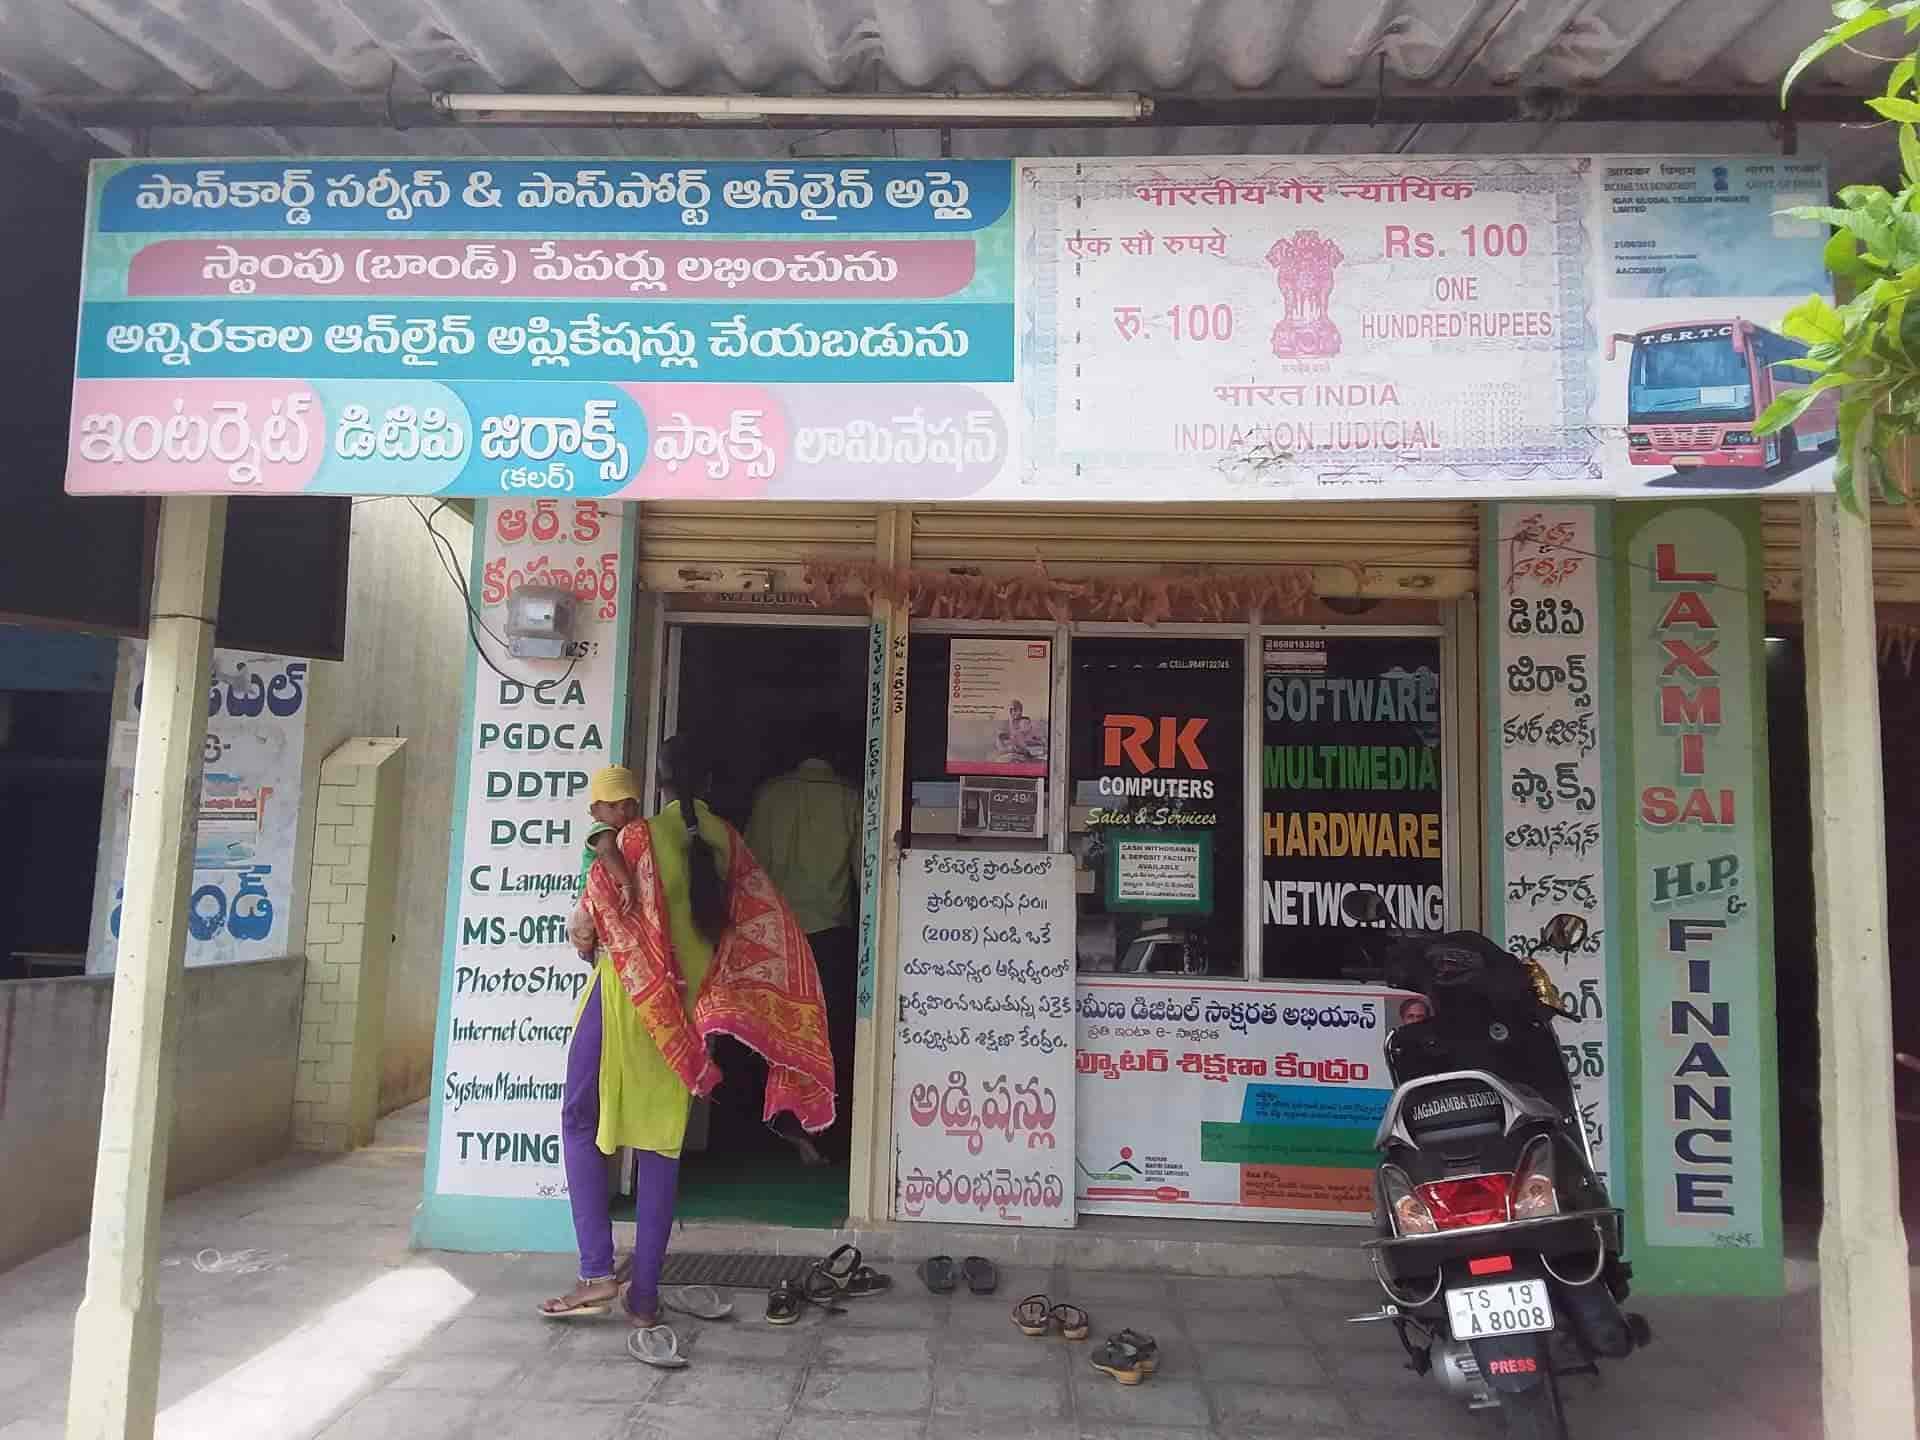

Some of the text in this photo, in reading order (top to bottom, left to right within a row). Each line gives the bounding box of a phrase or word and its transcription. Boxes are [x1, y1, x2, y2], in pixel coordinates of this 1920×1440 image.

[327, 169, 450, 221] సర్వీస్
[462, 170, 501, 209] &
[886, 171, 972, 220] అప్లై
[1136, 176, 1473, 206] भारतीय गैर न्यायिक
[1065, 228, 1227, 258] एक सौ रुपये
[1385, 223, 1528, 258] Rs. 100
[202, 241, 898, 294] స్టాంపు (బాండ్) పేపర్లు లభించును
[1435, 276, 1478, 302] ONE
[1168, 304, 1232, 341] 100
[1362, 312, 1551, 339] HUNDRED RUPEES
[107, 319, 312, 366] అన్నిరకాల
[488, 314, 698, 368] అప్లికేషన్లు
[708, 315, 969, 359] చేయబడును
[1214, 384, 1400, 407] भारत INDIA
[79, 392, 312, 485] ఇంటర్నెట్
[335, 404, 464, 460] డిటిపి
[480, 400, 629, 481] జిరాక్స్
[794, 404, 998, 473] లామినేషన్
[1174, 423, 1243, 450] INDIA
[1327, 420, 1440, 450] JUDICIAL
[500, 464, 575, 491] (కలర్)
[1656, 543, 1721, 776] LAXMI
[1507, 654, 1592, 707] జిరాక్స్
[1266, 677, 1439, 722] SOFTWARE
[479, 723, 603, 750] PGDCA
[1104, 714, 1208, 775] RK
[1263, 745, 1439, 790] MULTIMEDIA
[487, 771, 588, 798] DDTP
[1100, 776, 1215, 799] COMPUTERS
[1085, 807, 1216, 825] Sales & Services
[1641, 786, 1736, 826] SAI
[491, 820, 570, 844] DCH
[1263, 812, 1441, 858] HARDWARE
[470, 865, 582, 900] C Languag
[983, 856, 1052, 881] ప్రాంతంలో
[922, 923, 1052, 948] (2008) నుండి ఒకే
[456, 966, 588, 999] PhotoShop
[453, 1017, 574, 1044] Internet Concep
[1131, 995, 1201, 1022] డిజిటల్
[1206, 1000, 1276, 1034] సాక్షరత
[1283, 1004, 1376, 1030] అభియాన్
[1275, 1051, 1369, 1083] కేంద్రం
[1669, 919, 1735, 1216] FINANCE
[446, 1072, 493, 1112] System
[1411, 1095, 1468, 1121] JAGADAMBA
[1469, 1091, 1503, 1109] HONDA
[457, 1131, 560, 1164] TYPING
[904, 1167, 1063, 1221] ప్రారంభమైనవి
[1463, 1285, 1533, 1310] TS 19
[1471, 1307, 1545, 1334] A 8008
[1489, 1358, 1537, 1375] PRESS
